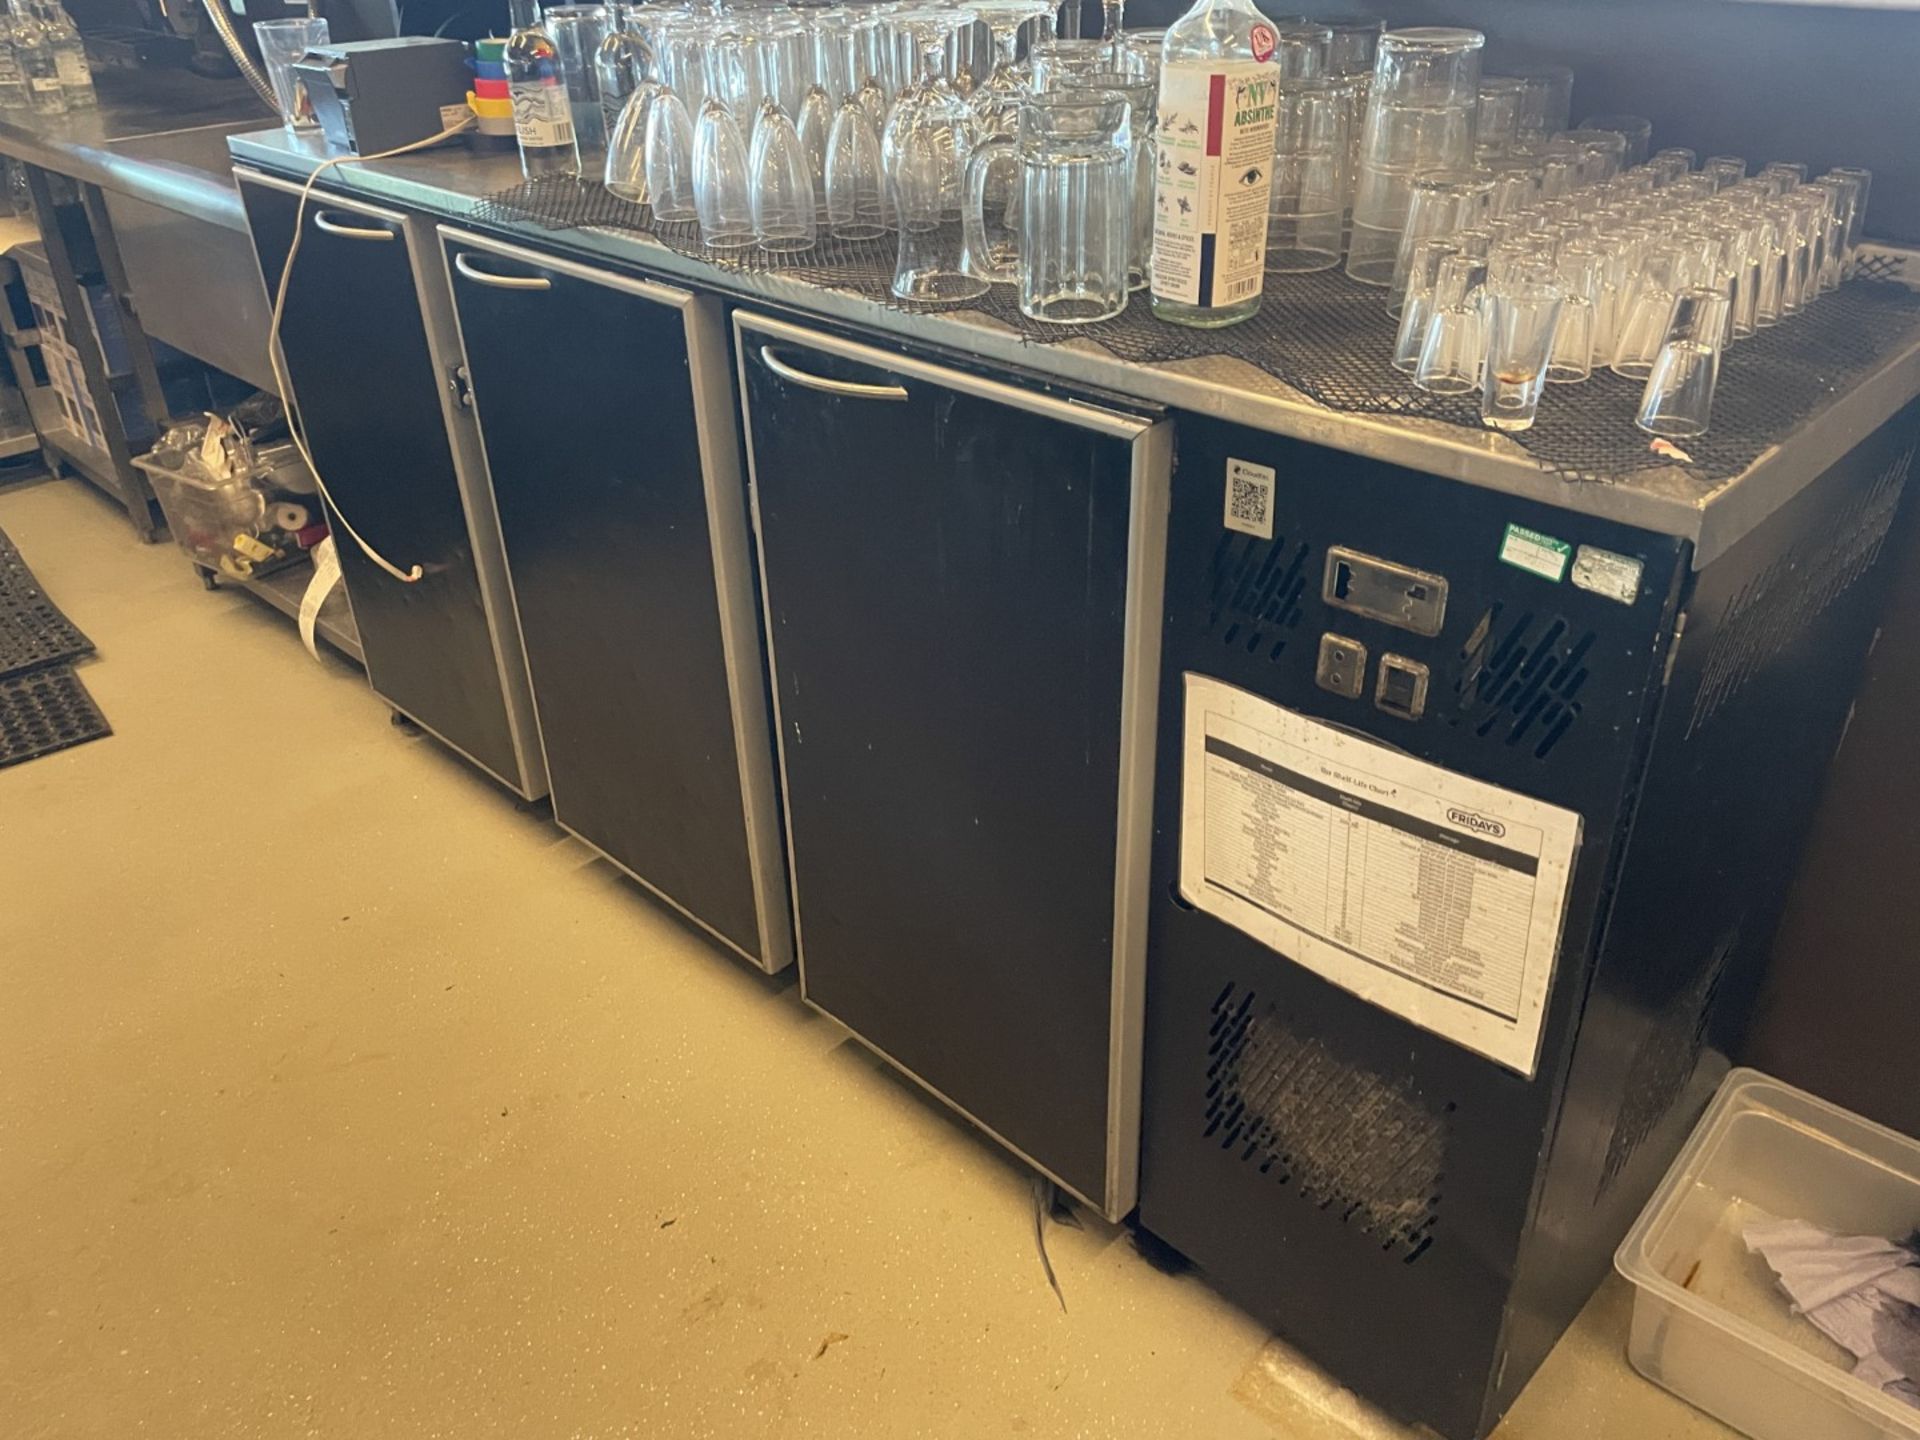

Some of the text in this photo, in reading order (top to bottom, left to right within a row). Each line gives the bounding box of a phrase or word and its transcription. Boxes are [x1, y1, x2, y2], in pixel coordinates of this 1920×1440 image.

[1234, 104, 1275, 127] ABSINTHE
[1509, 524, 1541, 541] PASSED
[1450, 811, 1501, 835] FRIDAYS
